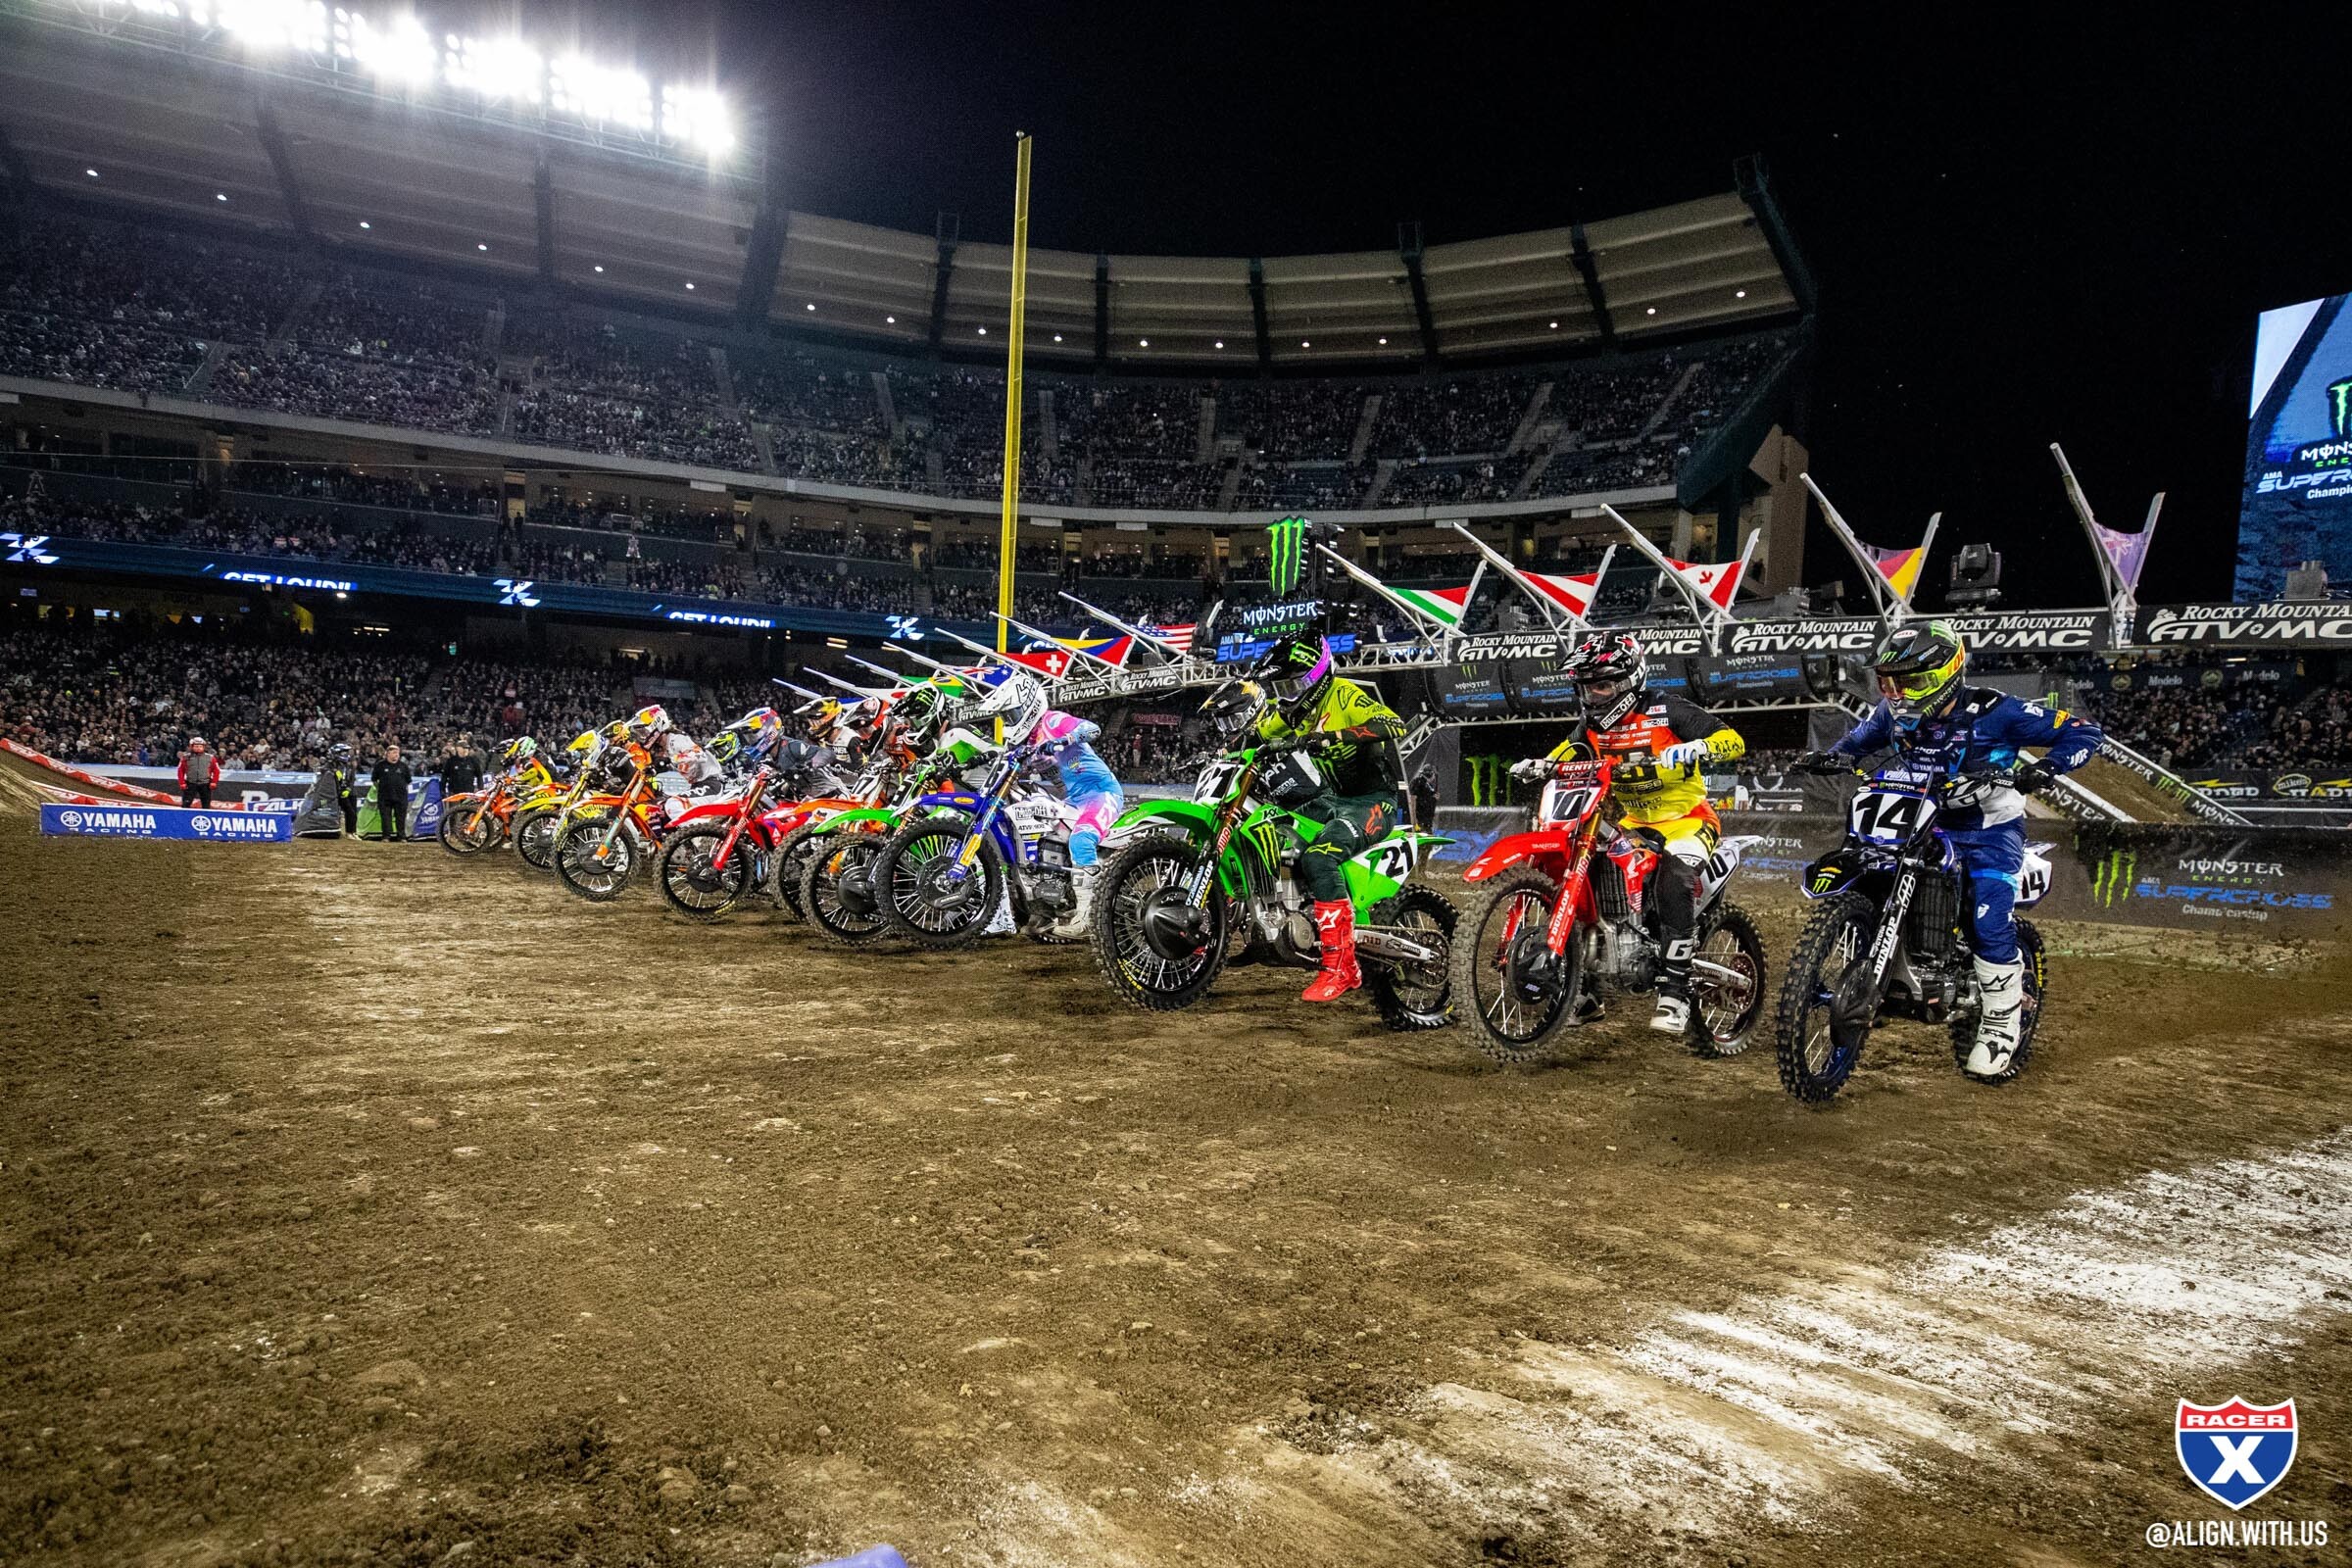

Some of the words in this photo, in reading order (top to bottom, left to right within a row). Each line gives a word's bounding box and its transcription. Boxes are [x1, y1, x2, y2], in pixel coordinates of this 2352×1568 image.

[2256, 468, 2352, 494] SUPER
[2263, 470, 2283, 480] AMA
[1243, 601, 1318, 626] MONSTER
[2180, 605, 2251, 620] ROCKY
[1253, 622, 1306, 636] ENERGY
[1753, 622, 1795, 636] ROCKY
[1796, 620, 1878, 634] MOUNTAIN
[1944, 616, 1996, 631] ROCKY
[1997, 614, 2096, 630] MOUNTAIN
[1471, 636, 1502, 648] ROCKY
[1502, 634, 1558, 646] MOUNTAIN
[1639, 628, 1703, 640] MOUNTAIN
[2148, 674, 2183, 686] Modelo
[2242, 669, 2280, 682] Mdelo
[1919, 763, 1945, 773] YAMHA
[1552, 789, 1592, 821] 10
[82, 812, 157, 829] YAMAHA
[1854, 793, 1923, 840] 14
[211, 817, 278, 834] YAMAHA
[1380, 841, 1414, 879] 21
[1705, 852, 1731, 884] 10
[2179, 858, 2284, 877] MONSTER
[1193, 859, 1214, 908] DUNLOP
[1551, 889, 1570, 935] DUNLOP
[1873, 915, 1896, 975] DUNLOP
